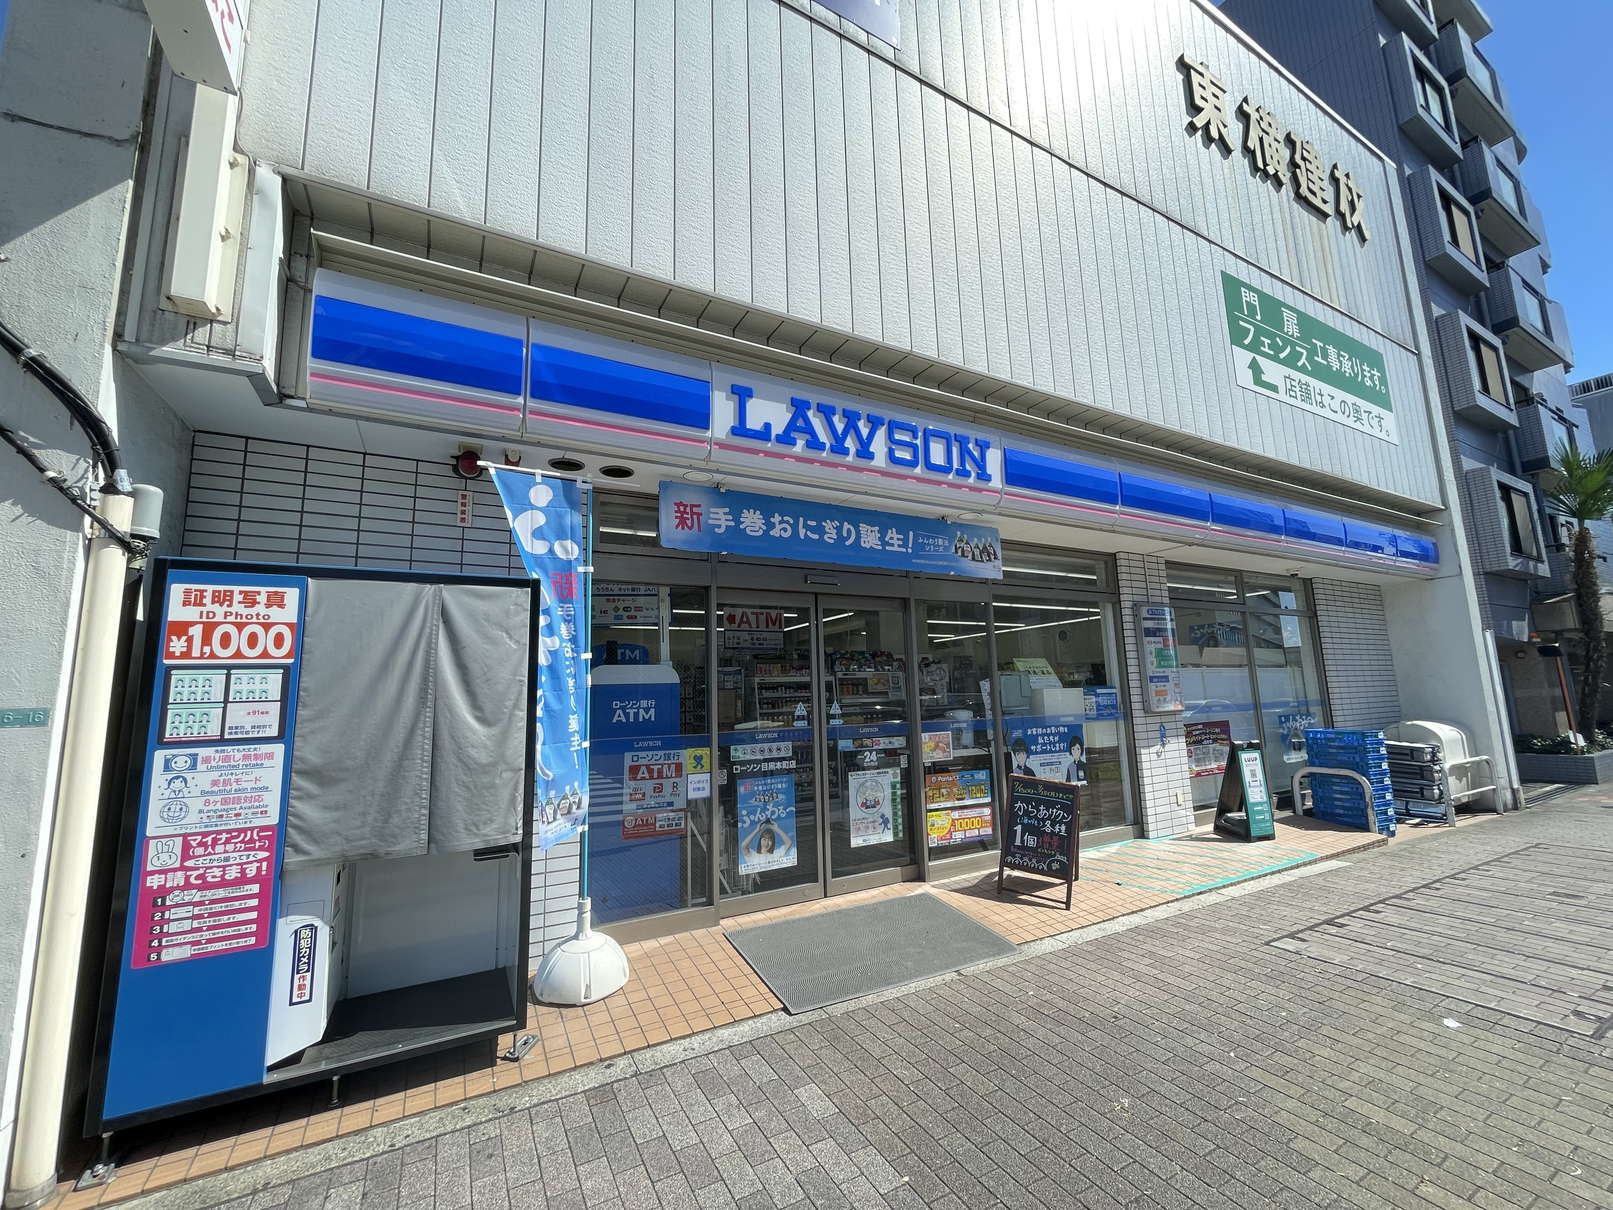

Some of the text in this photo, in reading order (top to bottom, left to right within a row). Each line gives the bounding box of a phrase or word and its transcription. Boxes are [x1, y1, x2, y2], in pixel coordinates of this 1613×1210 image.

[1239, 320, 1312, 371] フェンス
[1311, 339, 1387, 394] 工事承ります。
[1283, 374, 1390, 437] 店舗はこの奥です。
[730, 383, 992, 482] LAWSON
[181, 588, 287, 609] 証明写真
[199, 611, 271, 621] ID Photo
[736, 610, 783, 630] ATM
[168, 623, 293, 658] ¥1,000
[612, 700, 656, 709] ローソン銀行
[612, 709, 656, 723] ATM
[1030, 743, 1067, 752] サポートします!
[201, 752, 274, 765] 撮り直し無制限
[631, 752, 681, 763] ローソン銀行
[863, 751, 878, 762] 24
[206, 763, 240, 771] Unlimited
[636, 764, 676, 780] ATM
[733, 760, 797, 773] ローソン目黒本町店
[210, 776, 262, 788] 美肌モード
[200, 787, 233, 796] Beautiful
[239, 803, 269, 812] Available
[1013, 800, 1072, 822] からあげクン
[1041, 820, 1068, 836] 各種
[187, 829, 273, 847] マイナンバー
[193, 852, 259, 866] ここから撮ってすぐ
[146, 861, 268, 889] 申請できます!
